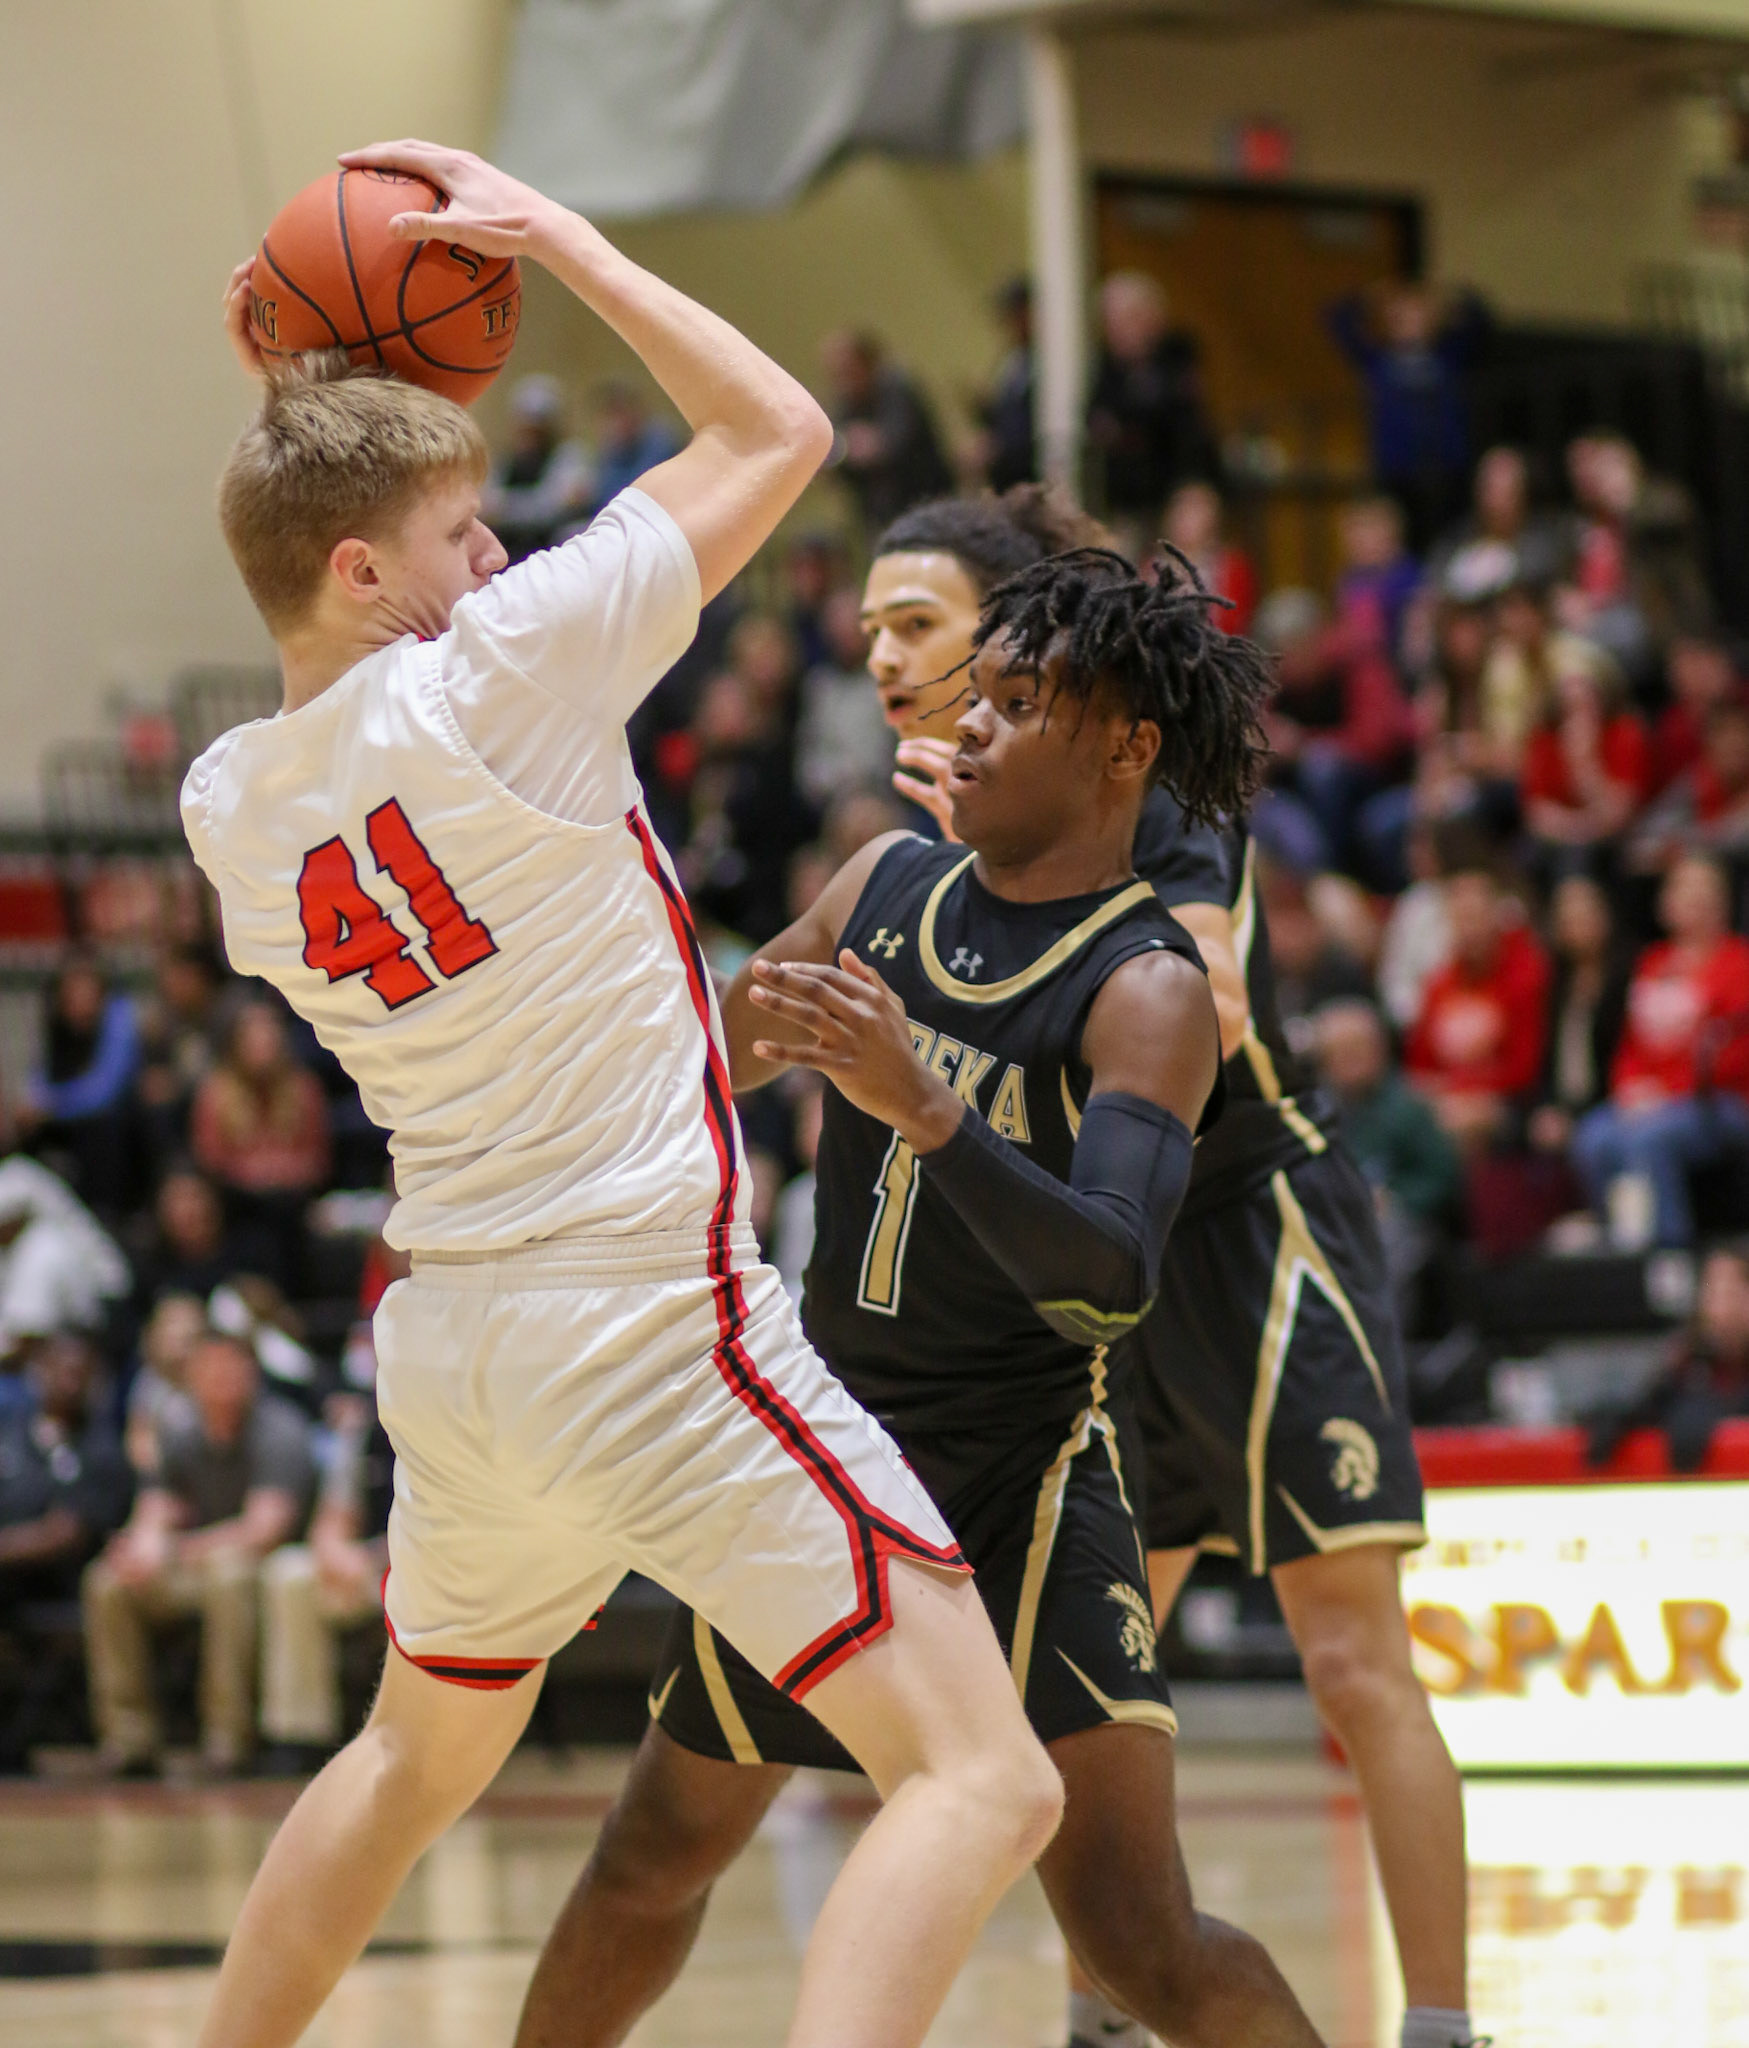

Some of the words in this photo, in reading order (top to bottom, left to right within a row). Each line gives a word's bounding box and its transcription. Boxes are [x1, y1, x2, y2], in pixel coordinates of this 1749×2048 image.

[297, 796, 501, 1012] 41
[857, 1129, 921, 1317] 1
[1409, 1601, 1742, 1698] SPAR
